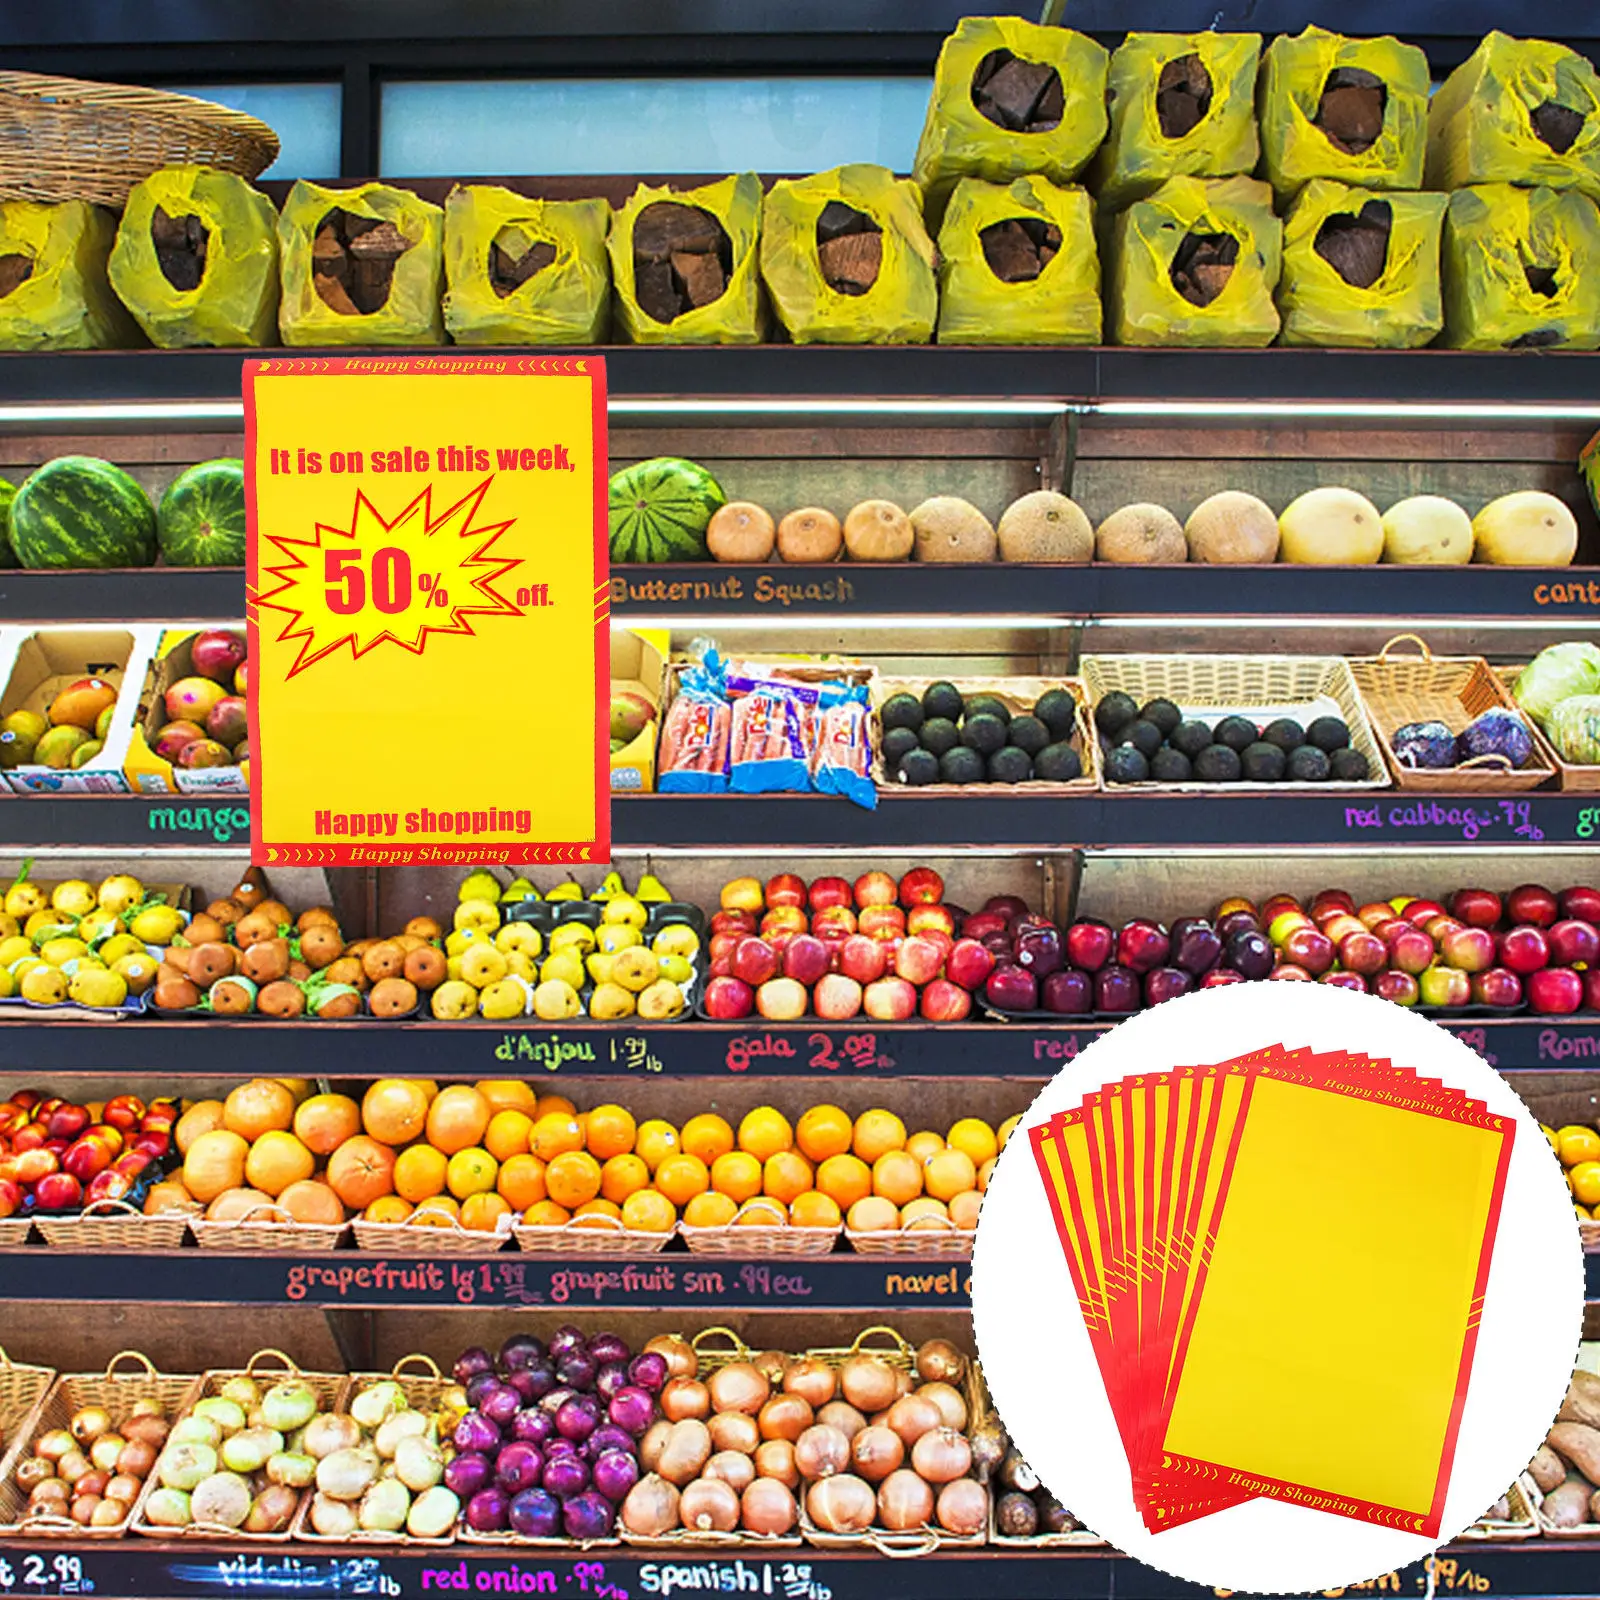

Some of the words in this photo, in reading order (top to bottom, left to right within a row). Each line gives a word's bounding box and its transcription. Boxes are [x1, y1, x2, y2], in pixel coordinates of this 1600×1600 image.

[344, 359, 410, 373] Happy
[413, 359, 508, 373] Shopping
[270, 448, 291, 474] It
[297, 448, 323, 474] is
[329, 451, 364, 473] on
[371, 446, 430, 473] sale
[437, 445, 490, 472] this
[496, 444, 576, 473] week,
[516, 584, 555, 607] off.
[610, 575, 743, 602] Butternut
[753, 575, 855, 605] Squash
[149, 807, 250, 842] mango
[314, 809, 399, 837] Happy
[405, 806, 532, 835] shopping
[1344, 804, 1384, 827] red
[350, 847, 413, 863] Happy
[414, 847, 511, 863] Shopping
[495, 1033, 597, 1070] d'Anjou
[725, 1033, 797, 1072] gala
[1033, 1033, 1079, 1060] red
[1538, 1028, 1600, 1061] Rom
[1323, 1077, 1374, 1101] Happy
[1374, 1086, 1446, 1115] Shopping
[286, 1260, 446, 1300] grapefruit
[451, 1262, 475, 1303] lg
[551, 1264, 676, 1302] grapefruit
[683, 1271, 727, 1293] sm
[885, 1267, 958, 1295] navel
[1228, 1472, 1282, 1496] Happy
[1282, 1485, 1359, 1516] Shopping
[378, 1575, 402, 1597] lb
[421, 1563, 470, 1590] red
[478, 1566, 558, 1593] onion
[638, 1560, 759, 1596] Spanish
